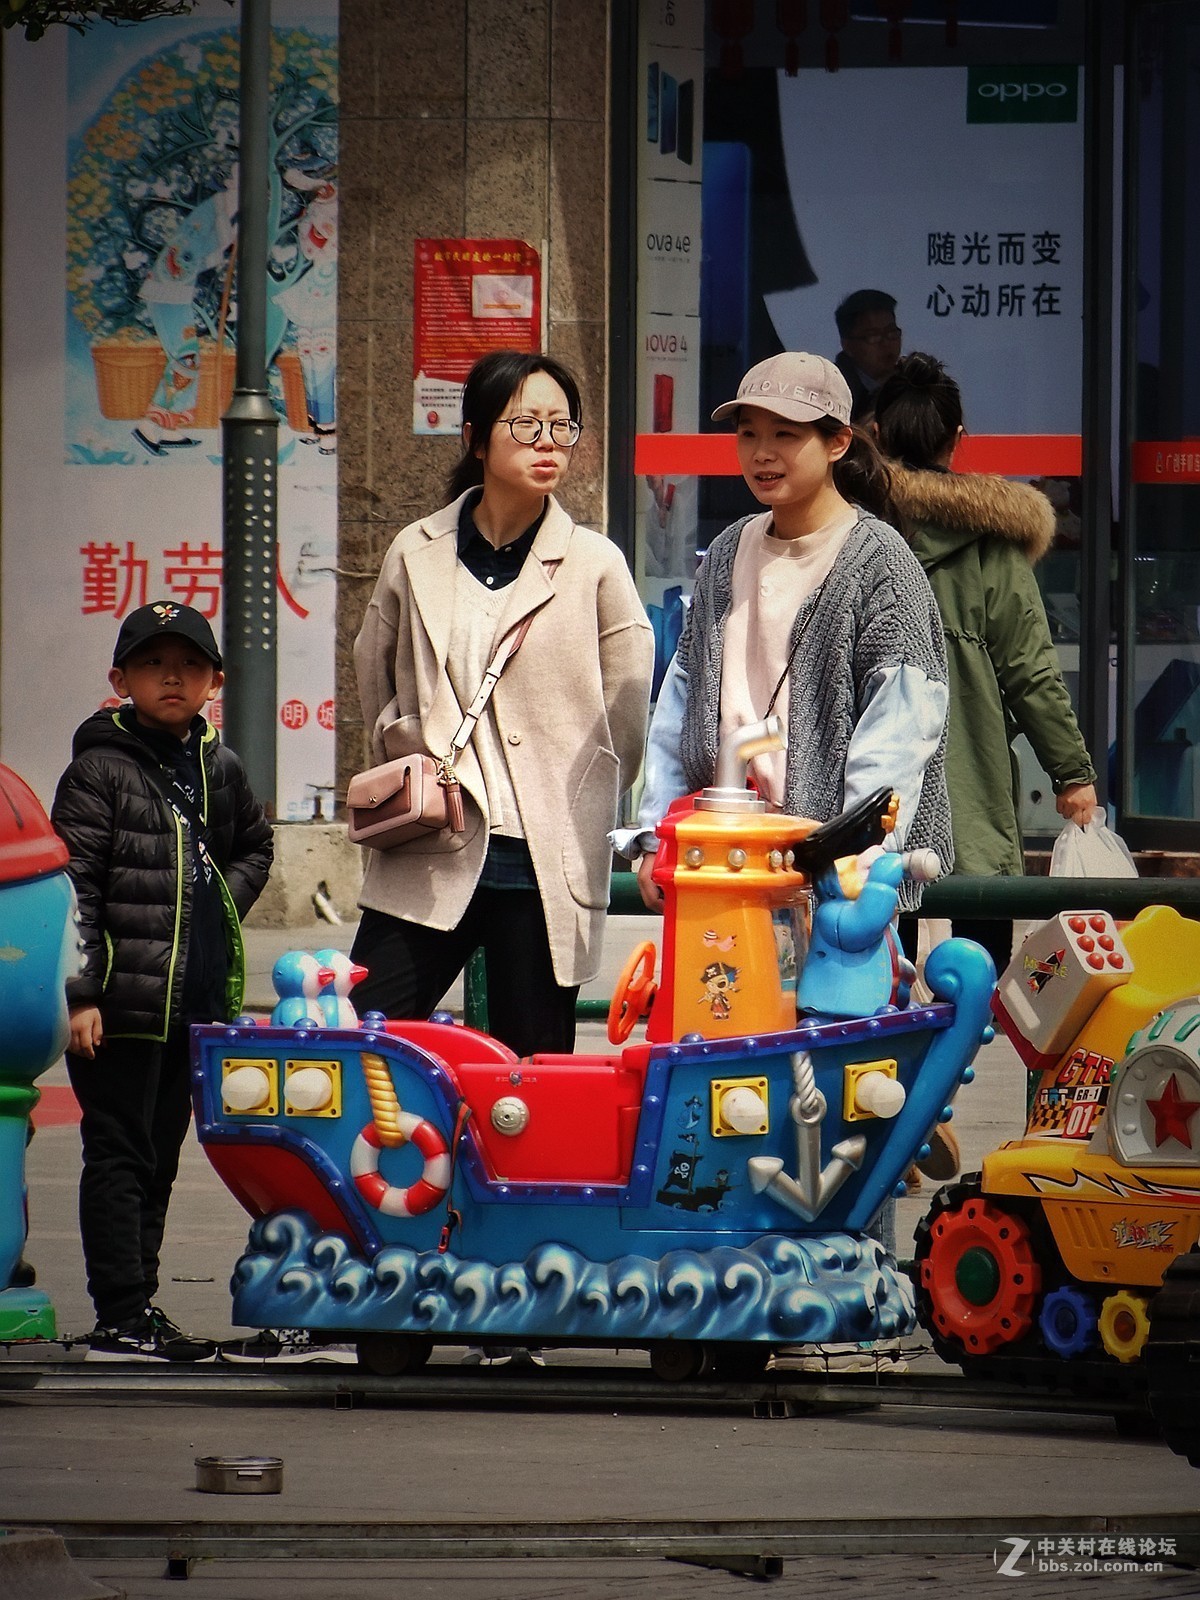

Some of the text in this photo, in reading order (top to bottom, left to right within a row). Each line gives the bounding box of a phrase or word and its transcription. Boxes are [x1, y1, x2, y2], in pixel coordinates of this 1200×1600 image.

[977, 83, 1067, 102] oppo
[926, 231, 1062, 266] 随光而变
[926, 283, 1062, 318] 心动所在
[680, 335, 688, 353] 4
[1076, 1088, 1099, 1101] GR-1
[1066, 1105, 1093, 1135] 01
